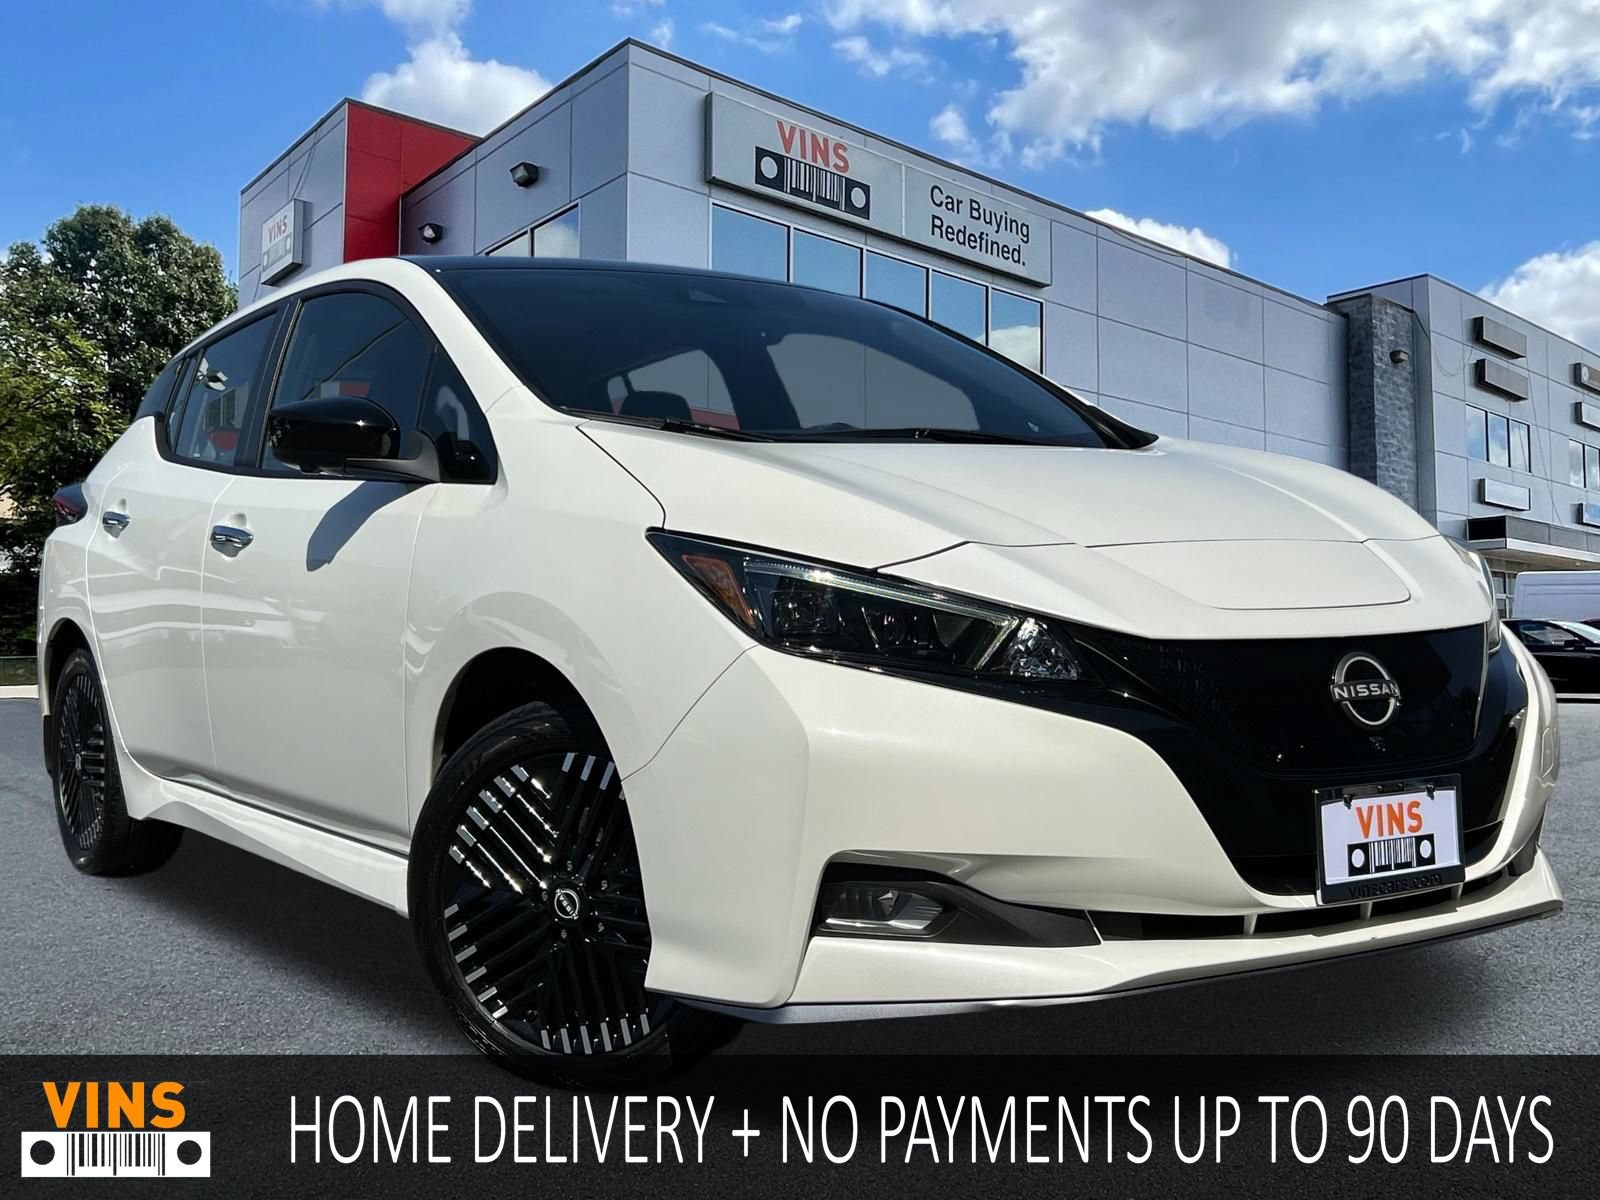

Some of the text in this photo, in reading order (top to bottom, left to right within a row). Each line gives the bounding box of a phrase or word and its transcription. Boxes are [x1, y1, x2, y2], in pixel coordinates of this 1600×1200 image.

[777, 120, 850, 173] VINS
[268, 214, 288, 243] VINS
[930, 184, 1030, 244] Car Buying
[931, 214, 1026, 266] Redefined.
[1333, 682, 1400, 700] NISSAN
[1356, 800, 1423, 839] VINS
